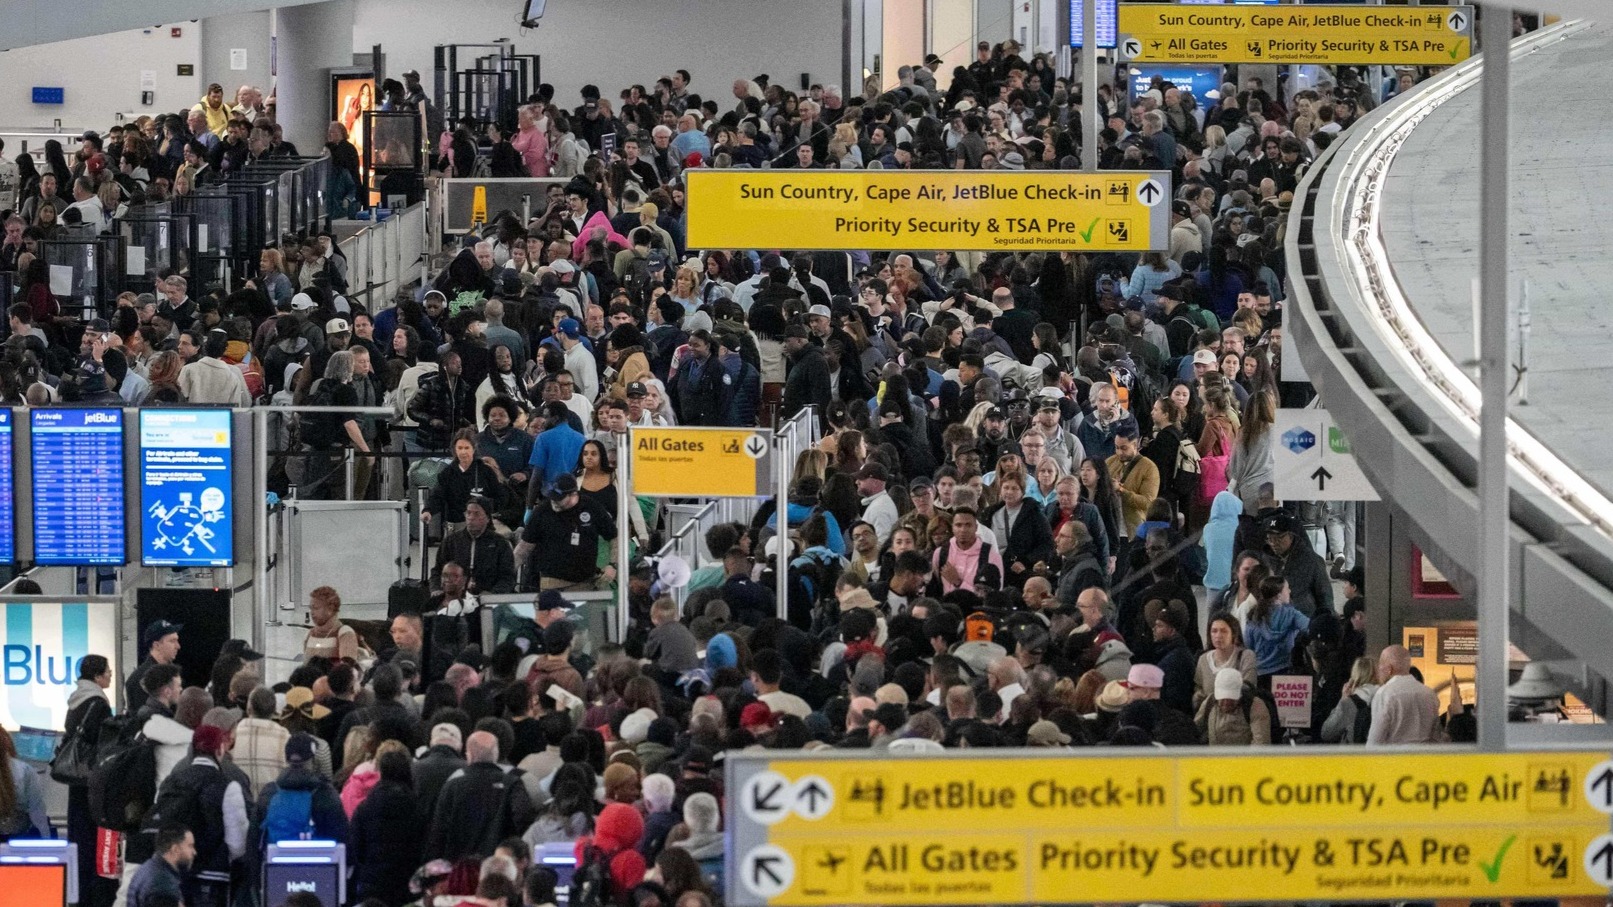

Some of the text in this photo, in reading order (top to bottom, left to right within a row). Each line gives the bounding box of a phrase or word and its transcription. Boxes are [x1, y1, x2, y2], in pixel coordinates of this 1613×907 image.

[1159, 14, 1421, 29] Sun Country, Cape Air, JetBlue Check-in
[1168, 39, 1228, 51] All Gates
[1269, 39, 1445, 54] Priority Security & TSA Pre
[741, 184, 1102, 203] Sun Country, Cape Air, JetBlue Check-in
[836, 217, 1075, 235] Priority Security & TSA Pre
[994, 236, 1077, 246] Seguridad Prioritaria
[35, 413, 62, 421] Arrivals
[84, 413, 117, 425] jetBlue
[638, 438, 704, 452] All Gates
[1276, 683, 1308, 691] PLEASE
[898, 778, 1165, 811] JetBlue Check-in
[1189, 774, 1523, 812] Sun Country, Cape Air
[862, 844, 1019, 874] All Gates
[1041, 837, 1471, 877] Priority Security & TSA Pre
